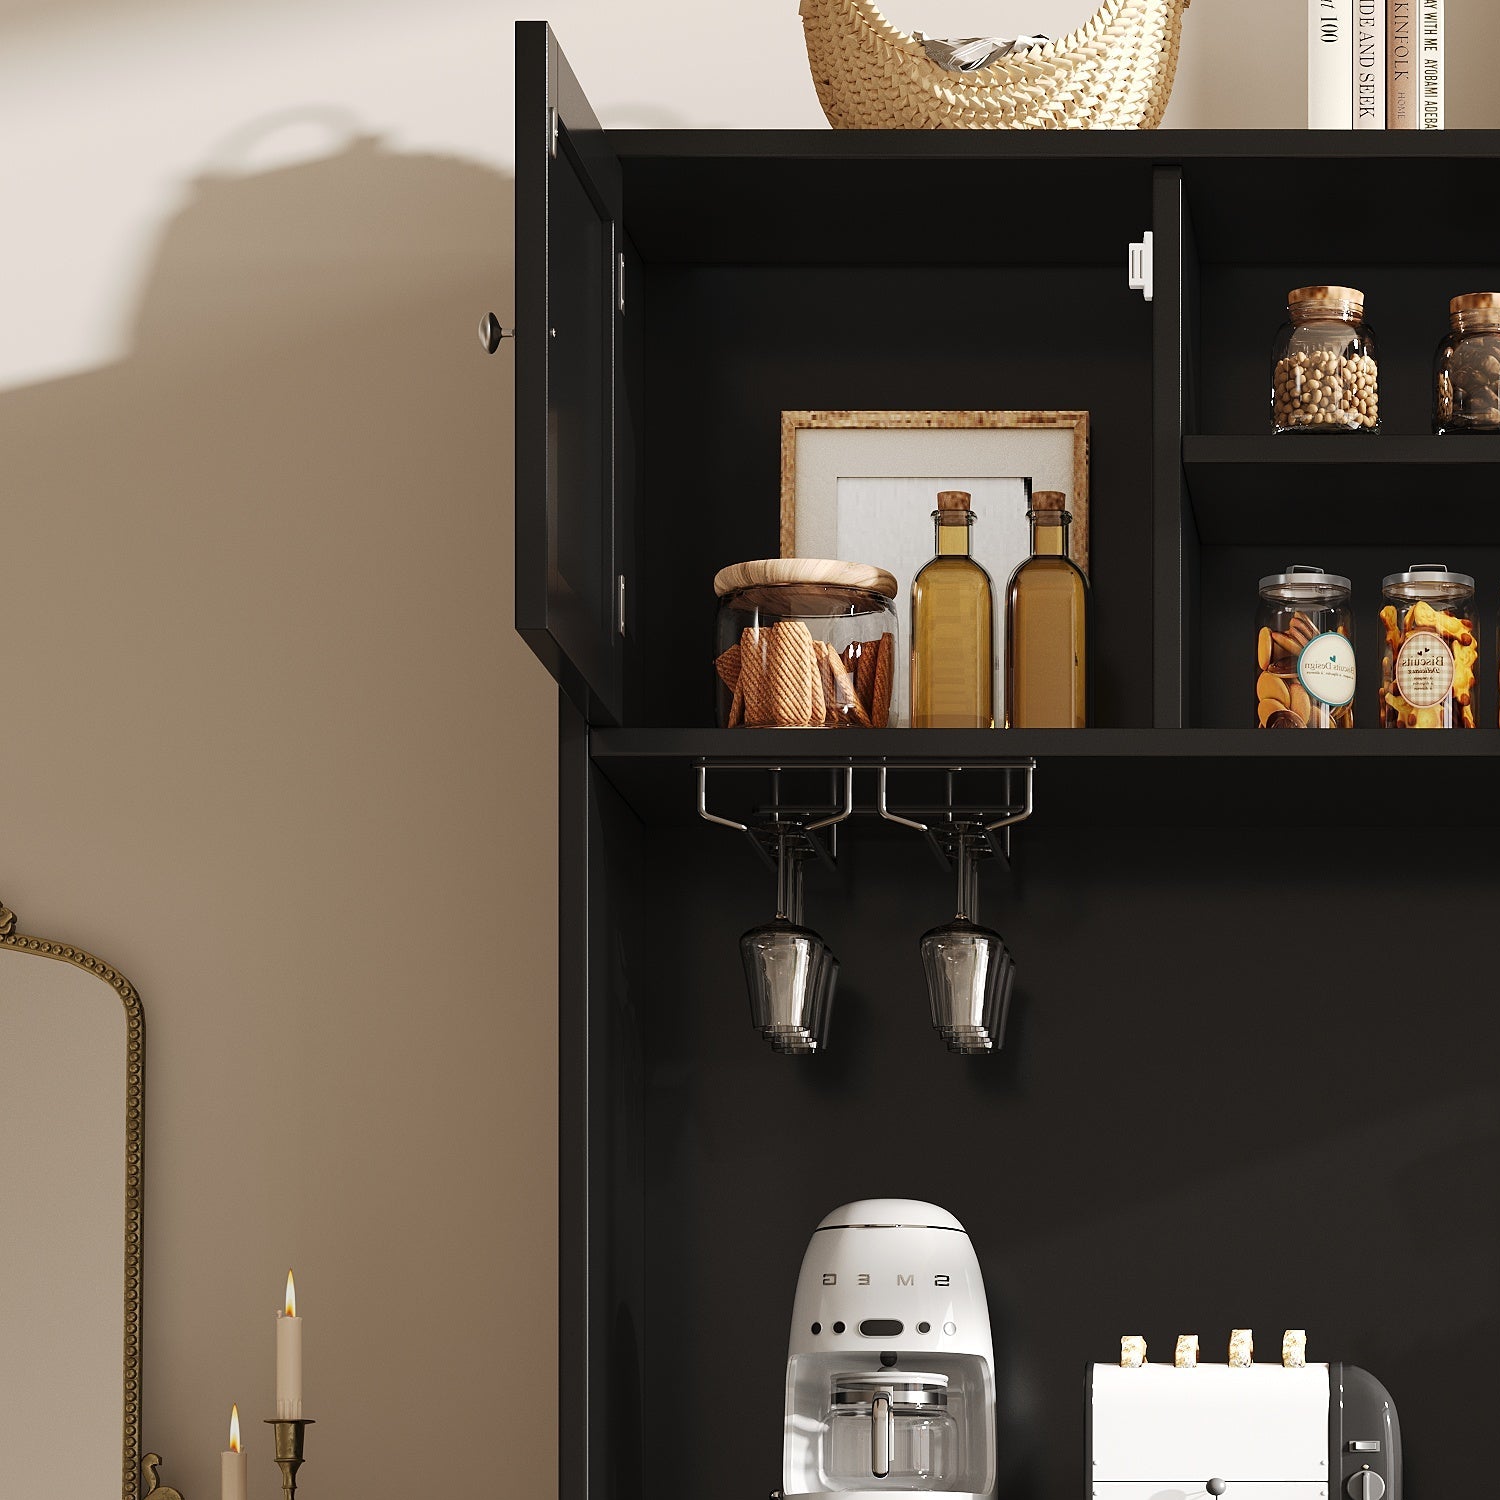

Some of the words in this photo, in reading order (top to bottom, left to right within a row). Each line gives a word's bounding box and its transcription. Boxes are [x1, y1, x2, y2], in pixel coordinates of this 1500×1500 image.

[1320, 16, 1339, 43] 100
[1424, 12, 1438, 38] WITH
[1359, 31, 1375, 68] AND
[1394, 2, 1409, 81] KINFOLK
[1424, 39, 1438, 52] ME
[1424, 59, 1438, 98] AYOBAMI
[1359, 73, 1375, 118] SEEK
[1397, 92, 1406, 119] HOME
